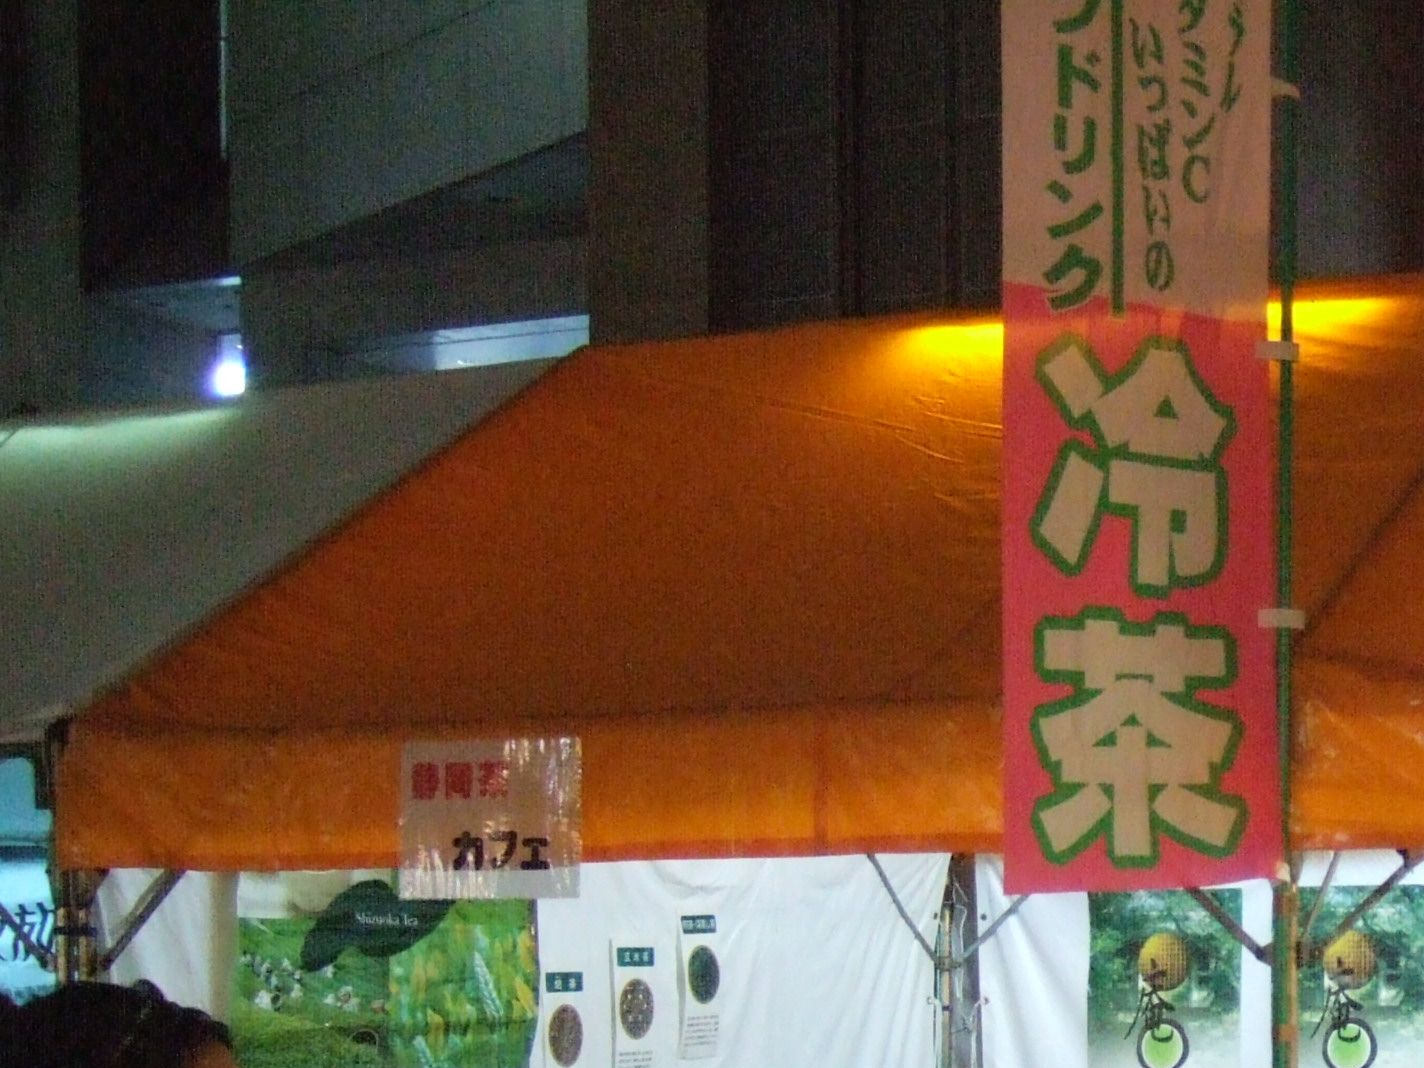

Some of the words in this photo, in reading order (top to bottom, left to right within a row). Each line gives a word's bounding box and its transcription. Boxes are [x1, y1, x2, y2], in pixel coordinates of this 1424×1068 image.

[1030, 333, 1248, 868] 冷茶
[452, 830, 551, 871] カフェ
